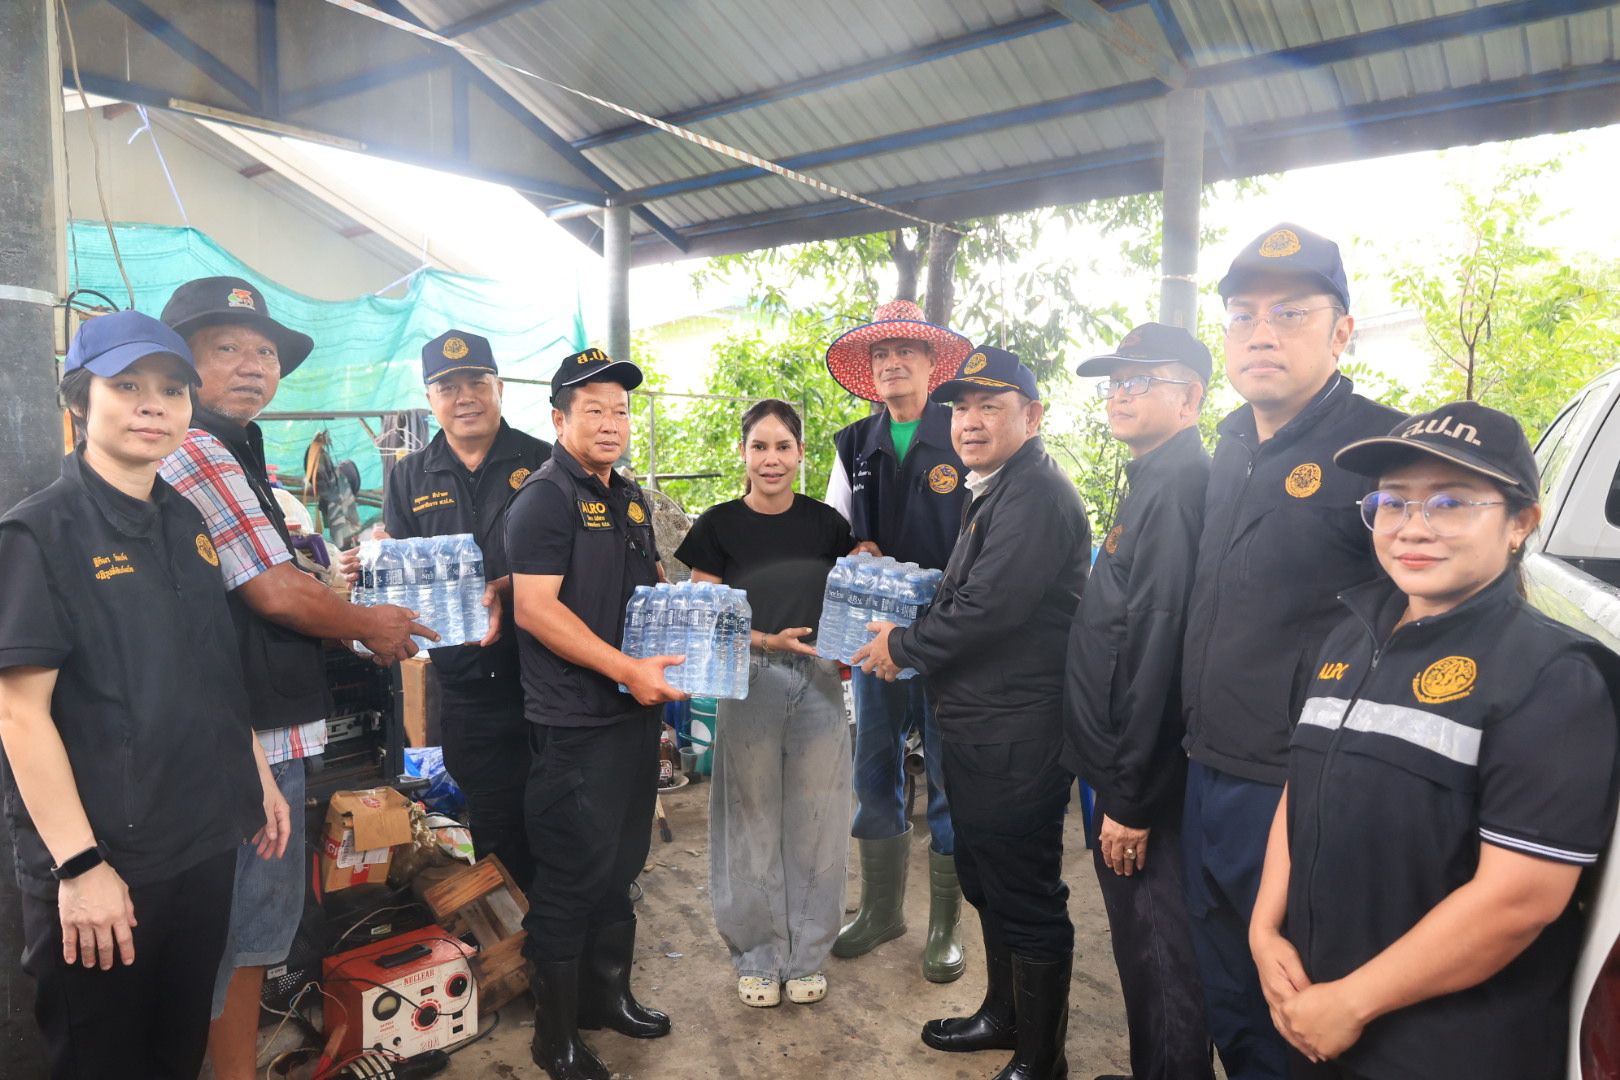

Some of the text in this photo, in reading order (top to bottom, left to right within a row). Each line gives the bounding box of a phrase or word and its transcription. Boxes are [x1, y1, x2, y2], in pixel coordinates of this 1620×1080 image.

[1401, 416, 1481, 446] ส.ป.ก.
[581, 501, 606, 514] ALRO
[403, 968, 435, 986] NUCLEAR
